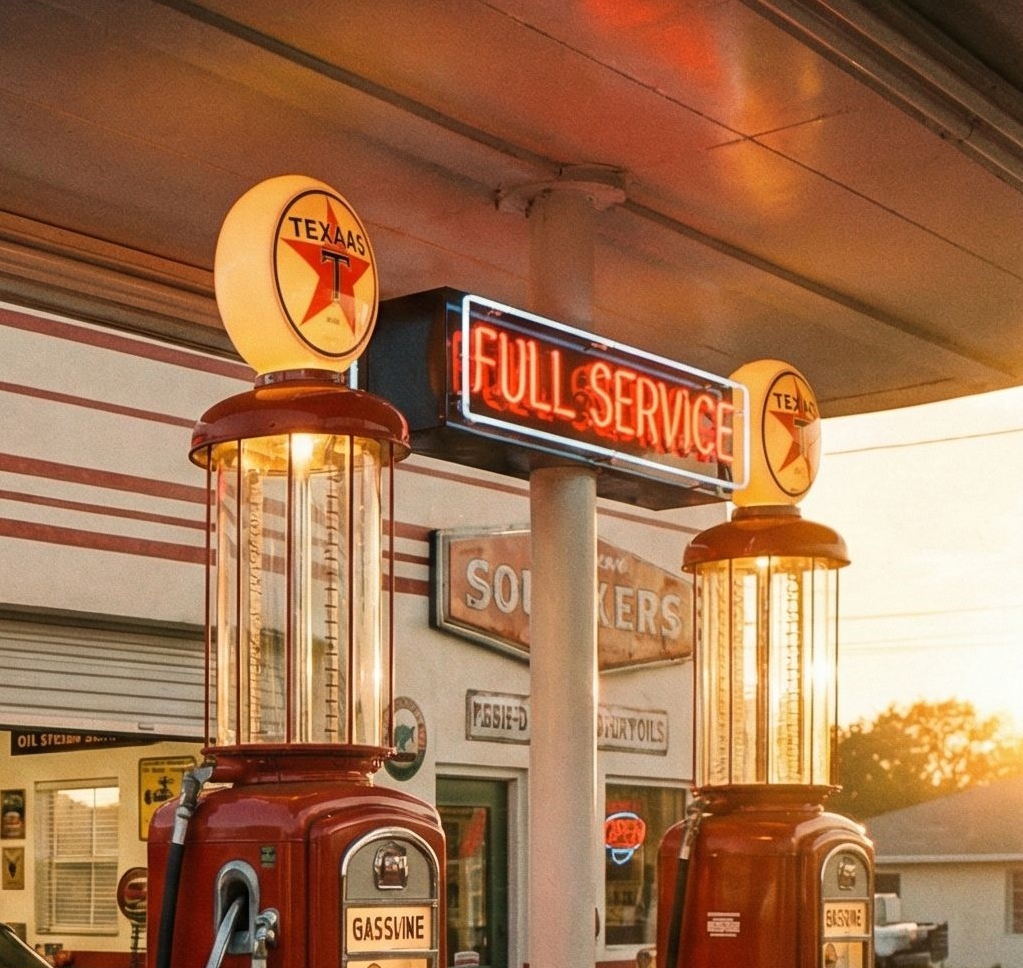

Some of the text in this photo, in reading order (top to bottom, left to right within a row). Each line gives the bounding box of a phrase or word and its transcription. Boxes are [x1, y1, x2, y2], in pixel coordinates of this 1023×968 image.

[288, 216, 366, 256] TEXAAS
[471, 324, 735, 463] FULL SERVICE
[17, 733, 38, 748] OIL
